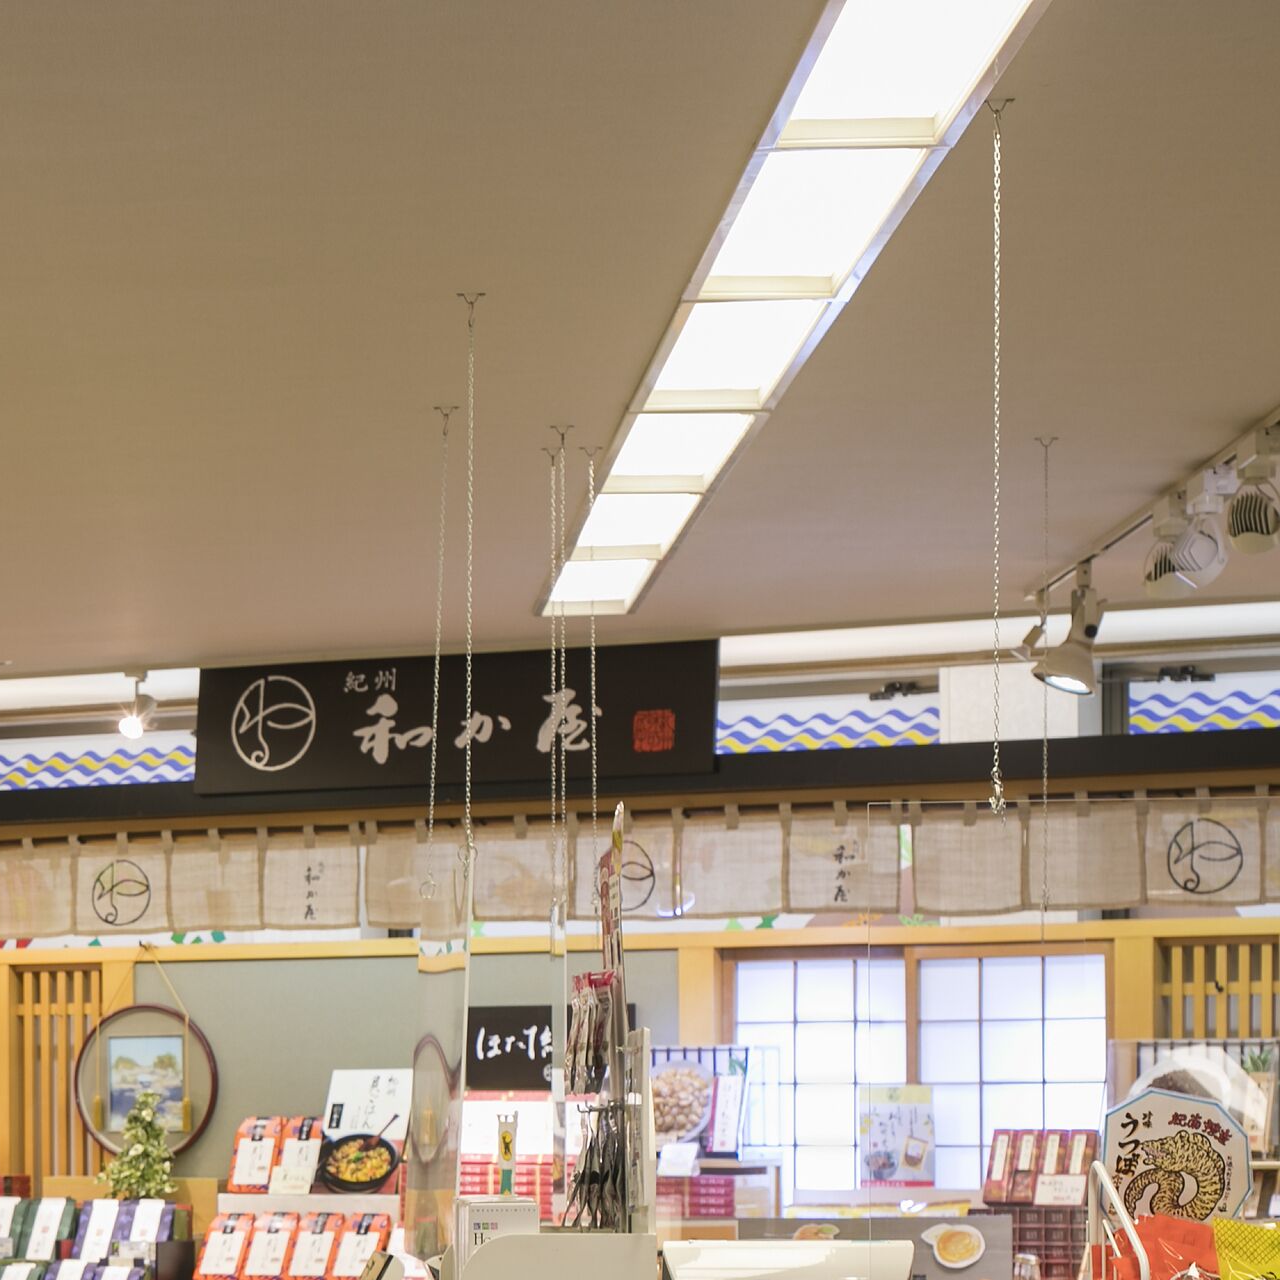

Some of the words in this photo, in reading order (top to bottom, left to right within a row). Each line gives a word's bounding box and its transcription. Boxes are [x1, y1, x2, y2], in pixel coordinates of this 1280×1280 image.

[343, 667, 397, 693] 紀州
[1116, 1112, 1140, 1177] うつぼ
